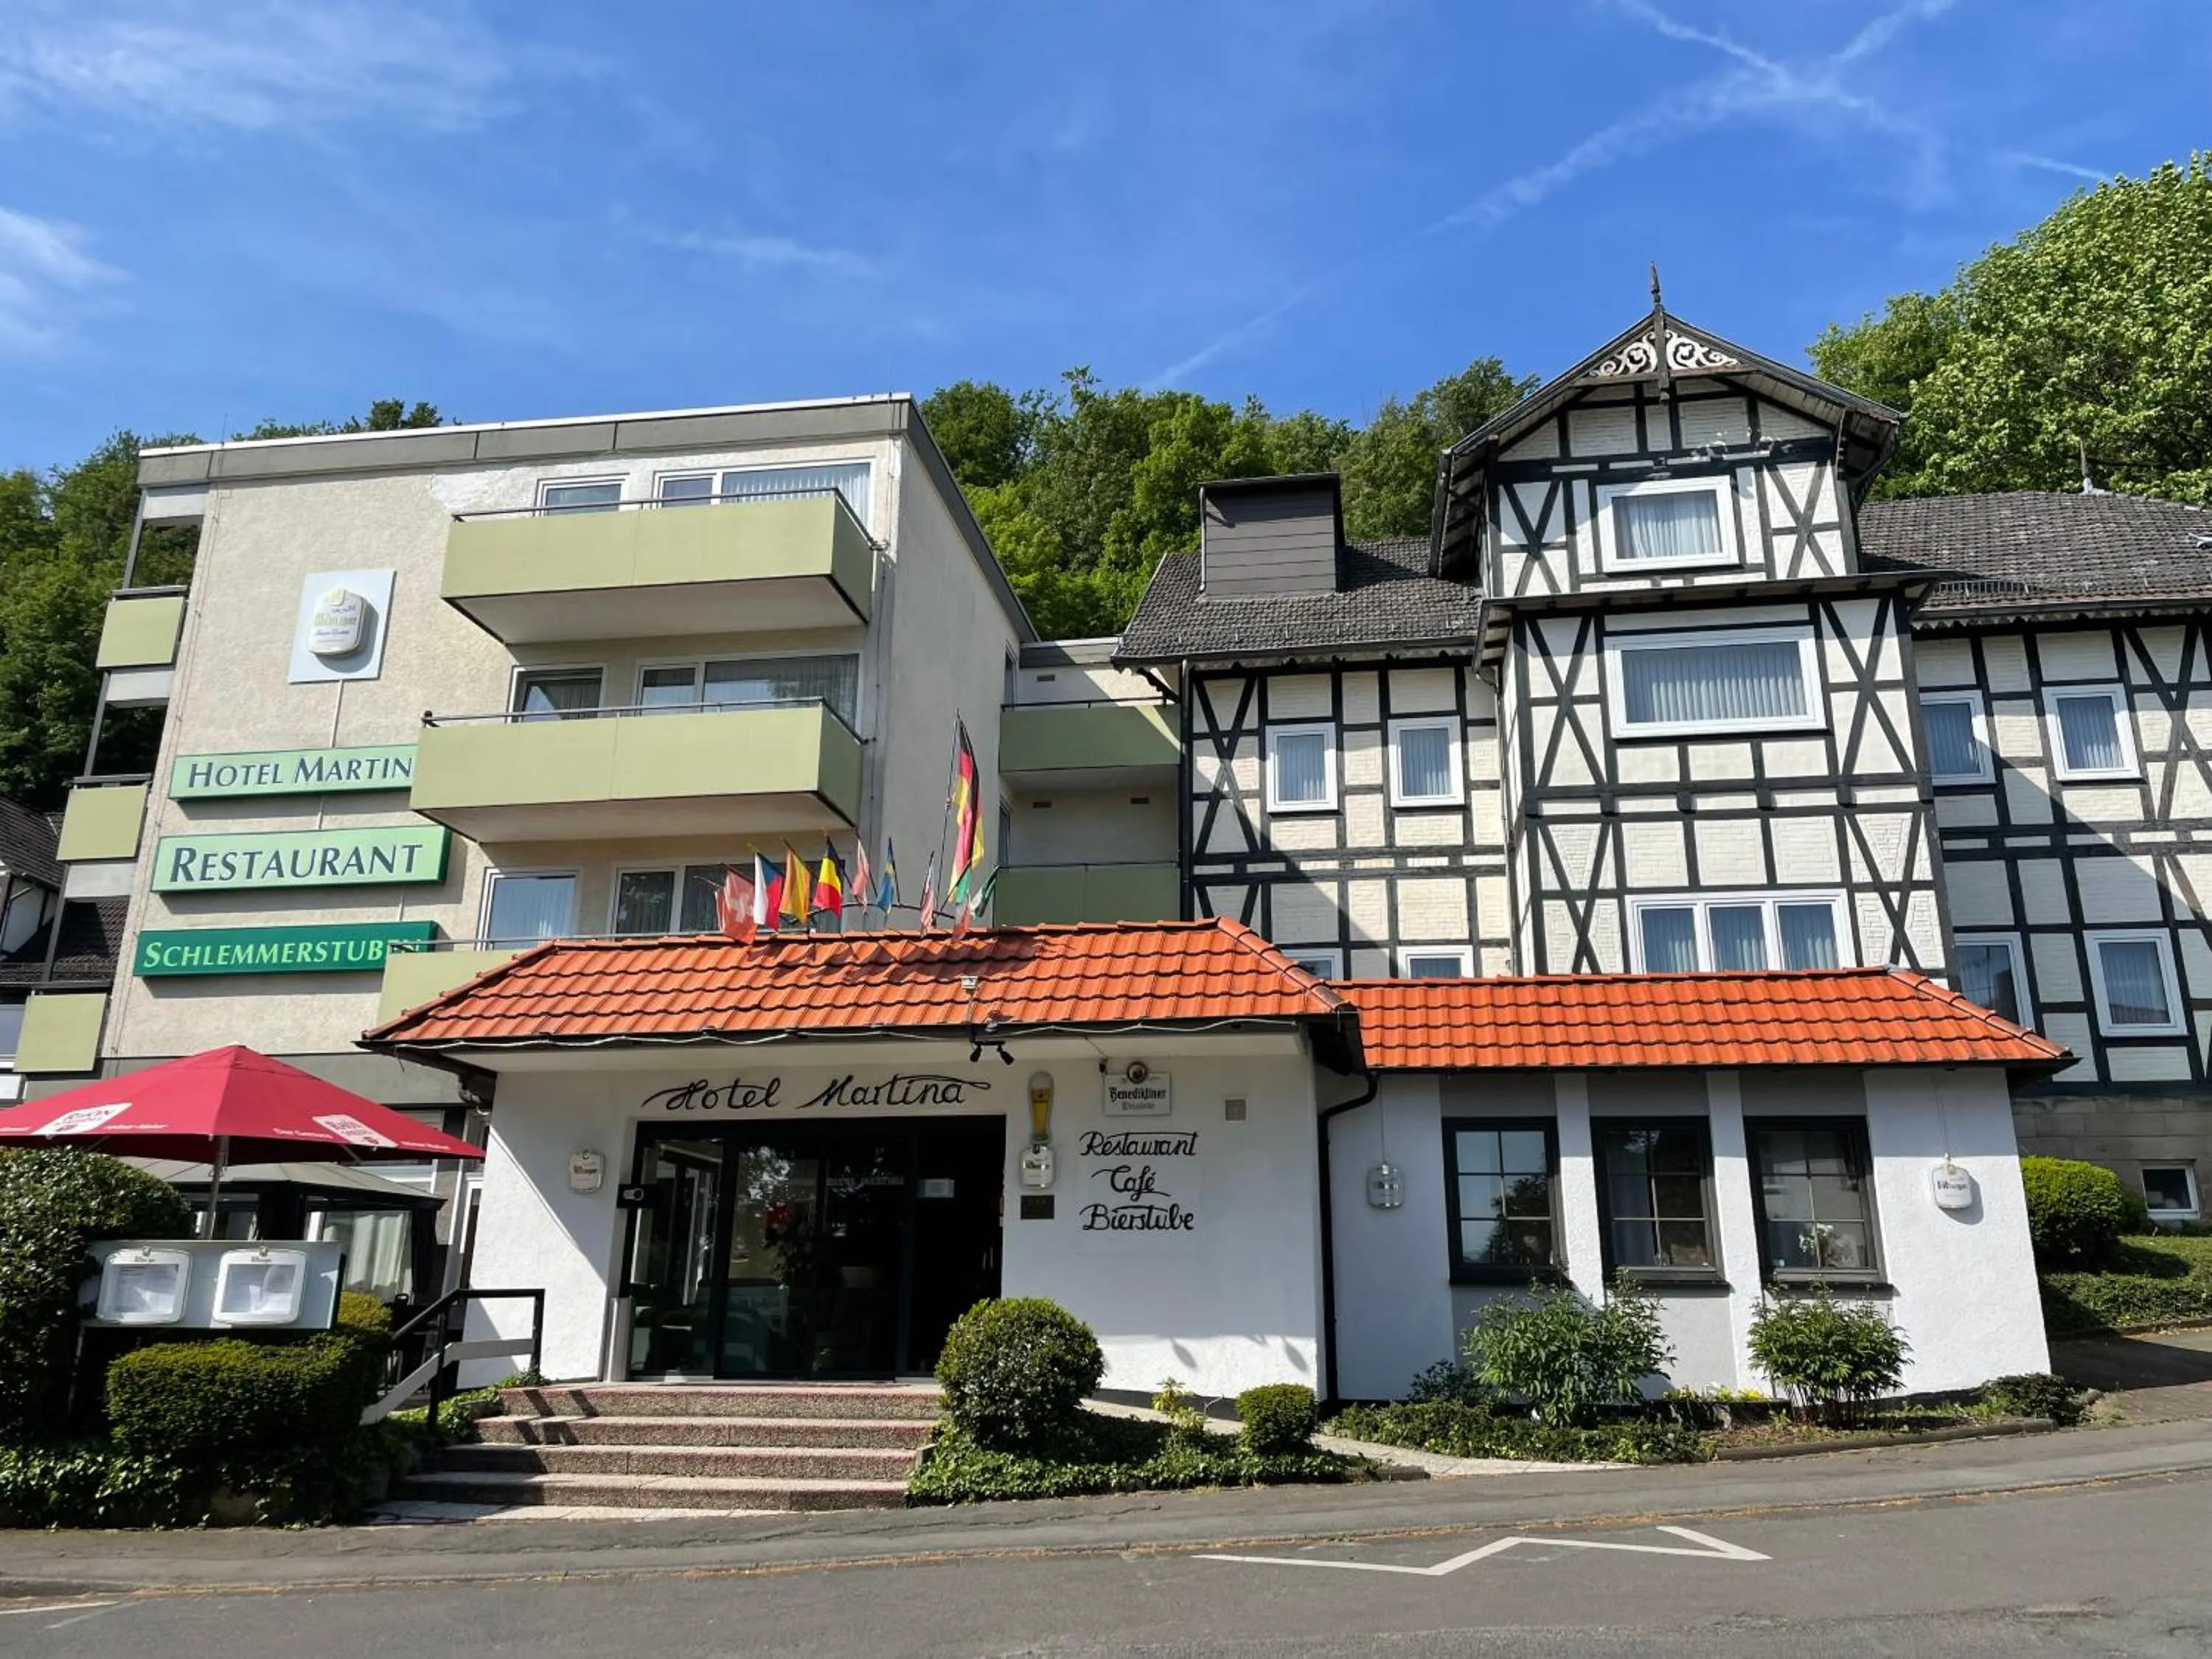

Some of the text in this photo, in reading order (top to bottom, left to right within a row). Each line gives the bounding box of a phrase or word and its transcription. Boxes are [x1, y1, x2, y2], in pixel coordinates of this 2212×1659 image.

[187, 756, 412, 789] HOTEL MARTIN
[170, 844, 423, 883] RESTAURANT
[640, 1074, 992, 1110] Hotel Martina
[1079, 1130, 1199, 1157] Restaurant
[1091, 1164, 1172, 1202] Café
[1079, 1203, 1194, 1231] Bierstube
